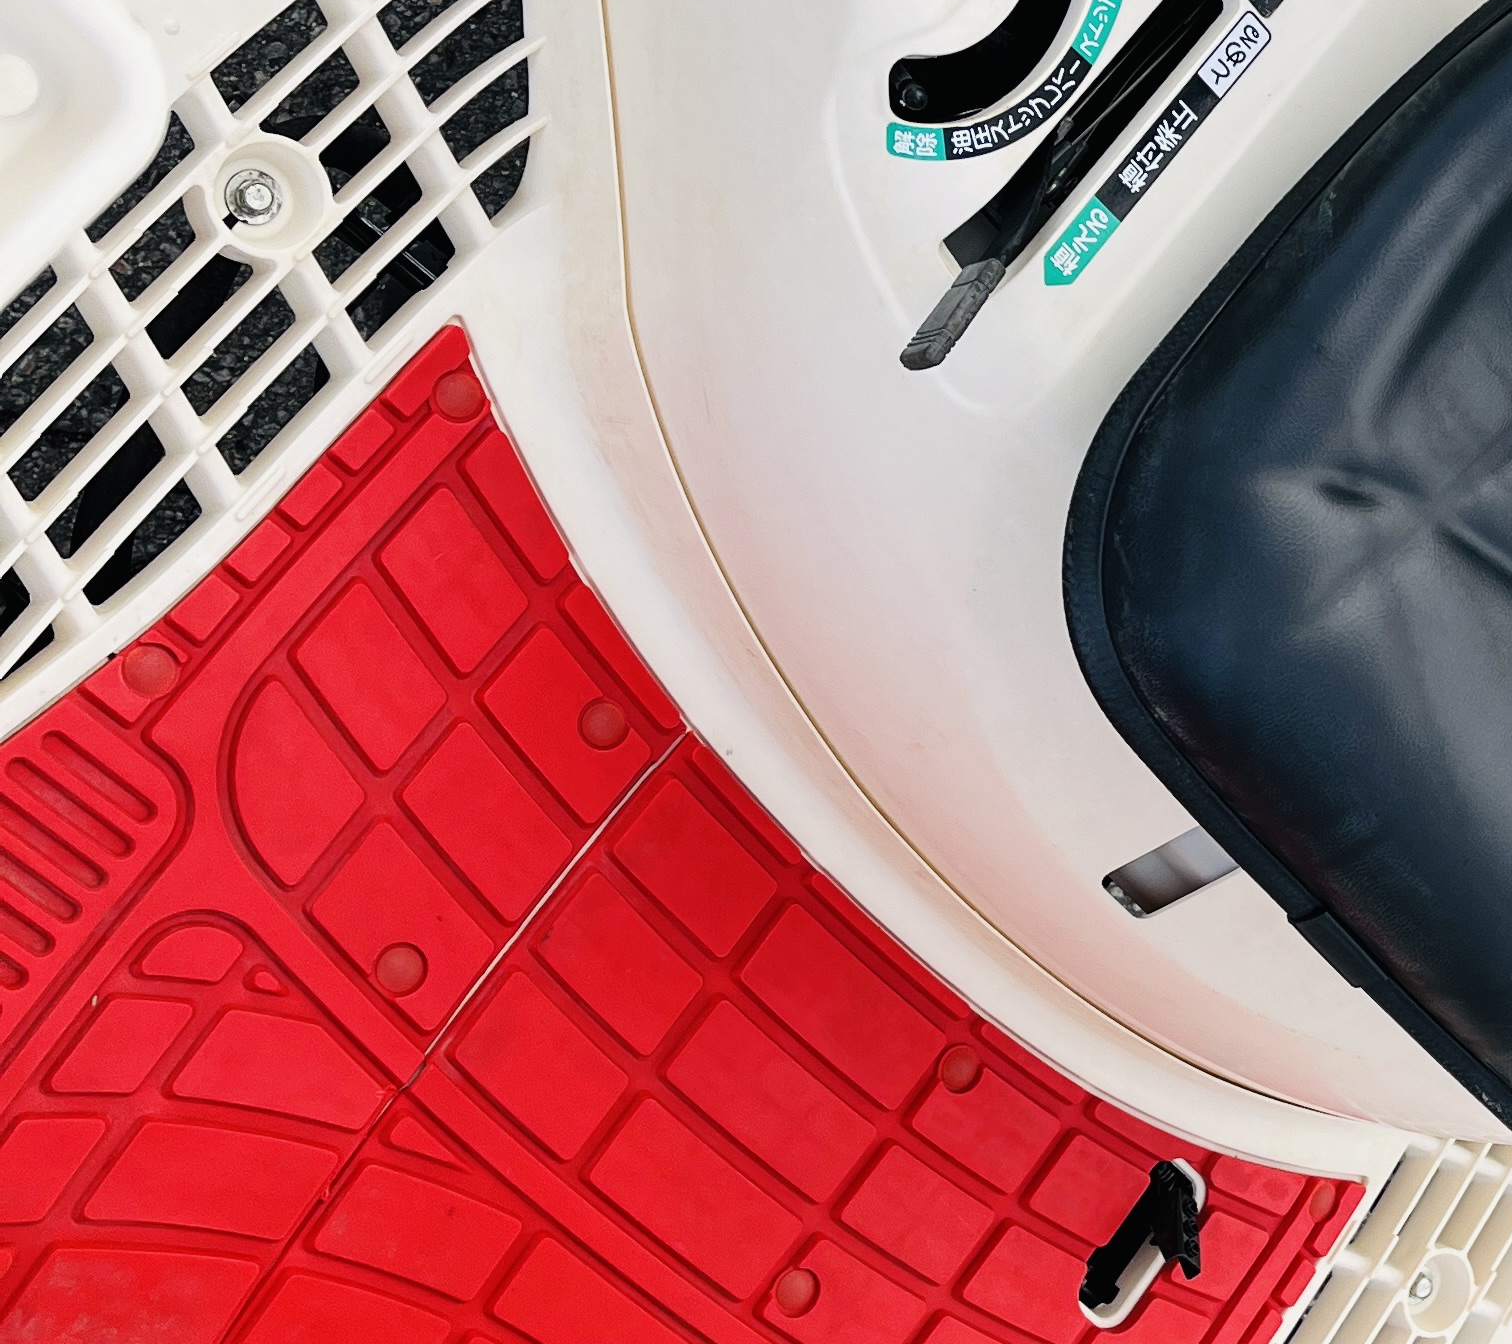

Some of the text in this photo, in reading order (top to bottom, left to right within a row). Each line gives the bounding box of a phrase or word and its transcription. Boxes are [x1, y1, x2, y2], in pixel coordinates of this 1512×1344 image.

[892, 129, 938, 157] 解除
[950, 58, 1081, 156] 油圧ストップレバー
[1049, 24, 1262, 277] 植える 植付条止 とめる
